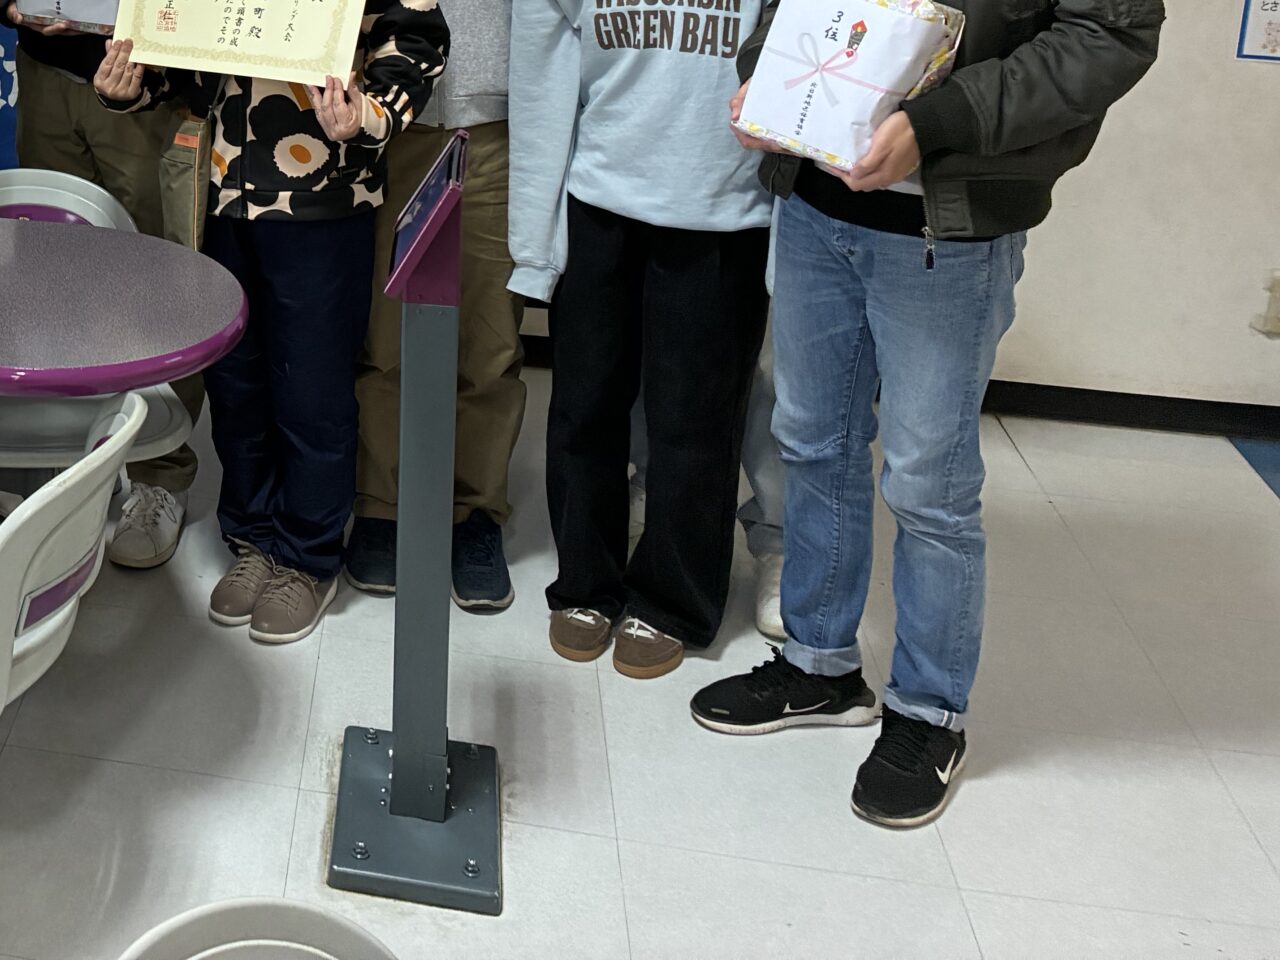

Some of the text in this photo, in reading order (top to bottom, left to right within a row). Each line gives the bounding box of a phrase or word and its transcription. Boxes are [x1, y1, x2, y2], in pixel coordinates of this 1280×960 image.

[593, 10, 741, 58] GREEN BAY
[824, 10, 844, 42] 3位
